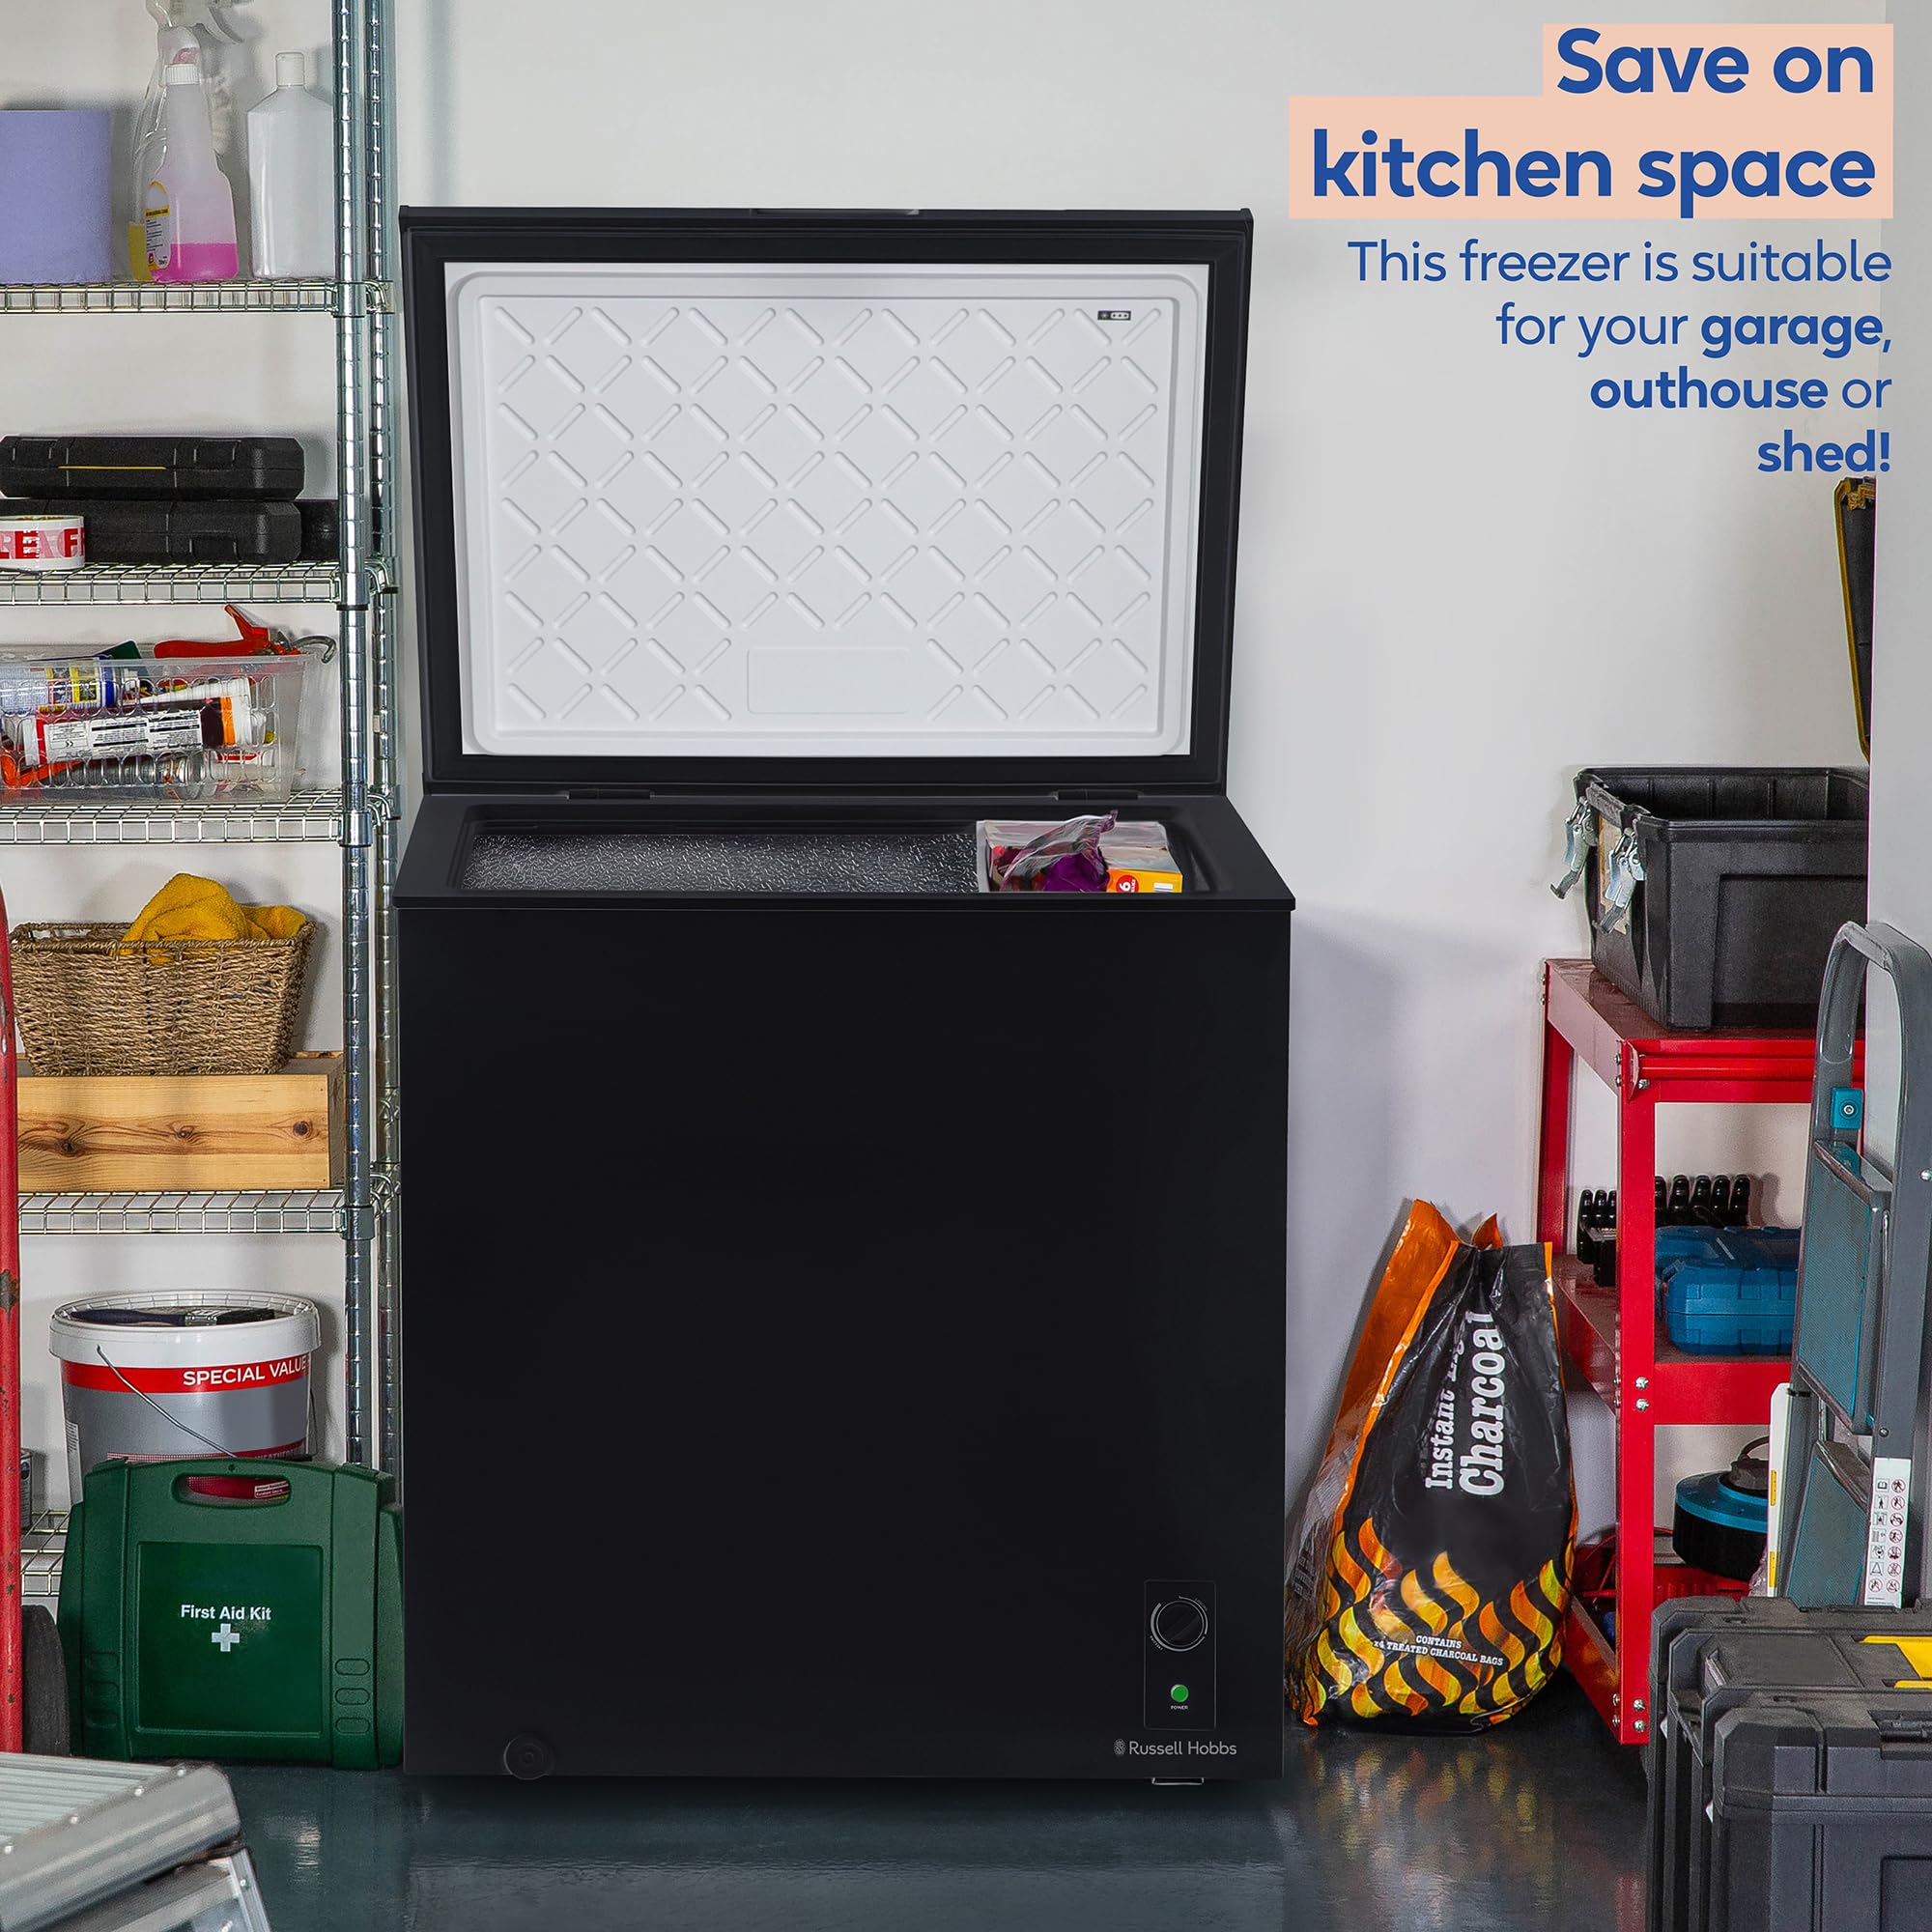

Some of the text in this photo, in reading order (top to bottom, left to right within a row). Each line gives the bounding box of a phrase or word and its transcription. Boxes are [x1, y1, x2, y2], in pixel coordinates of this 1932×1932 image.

[183, 1366, 266, 1386] SPECIAL
[1459, 1311, 1505, 1496] Charcoal
[1425, 1388, 1455, 1489] Instant
[181, 1605, 271, 1620] First Aid Kit
[1416, 1634, 1463, 1649] CONTAINS
[1386, 1642, 1429, 1655] TREATED
[1430, 1648, 1478, 1662] CHARCOAL
[1480, 1655, 1504, 1666] BAGS
[1129, 1741, 1237, 1755] Russell Hobbs
